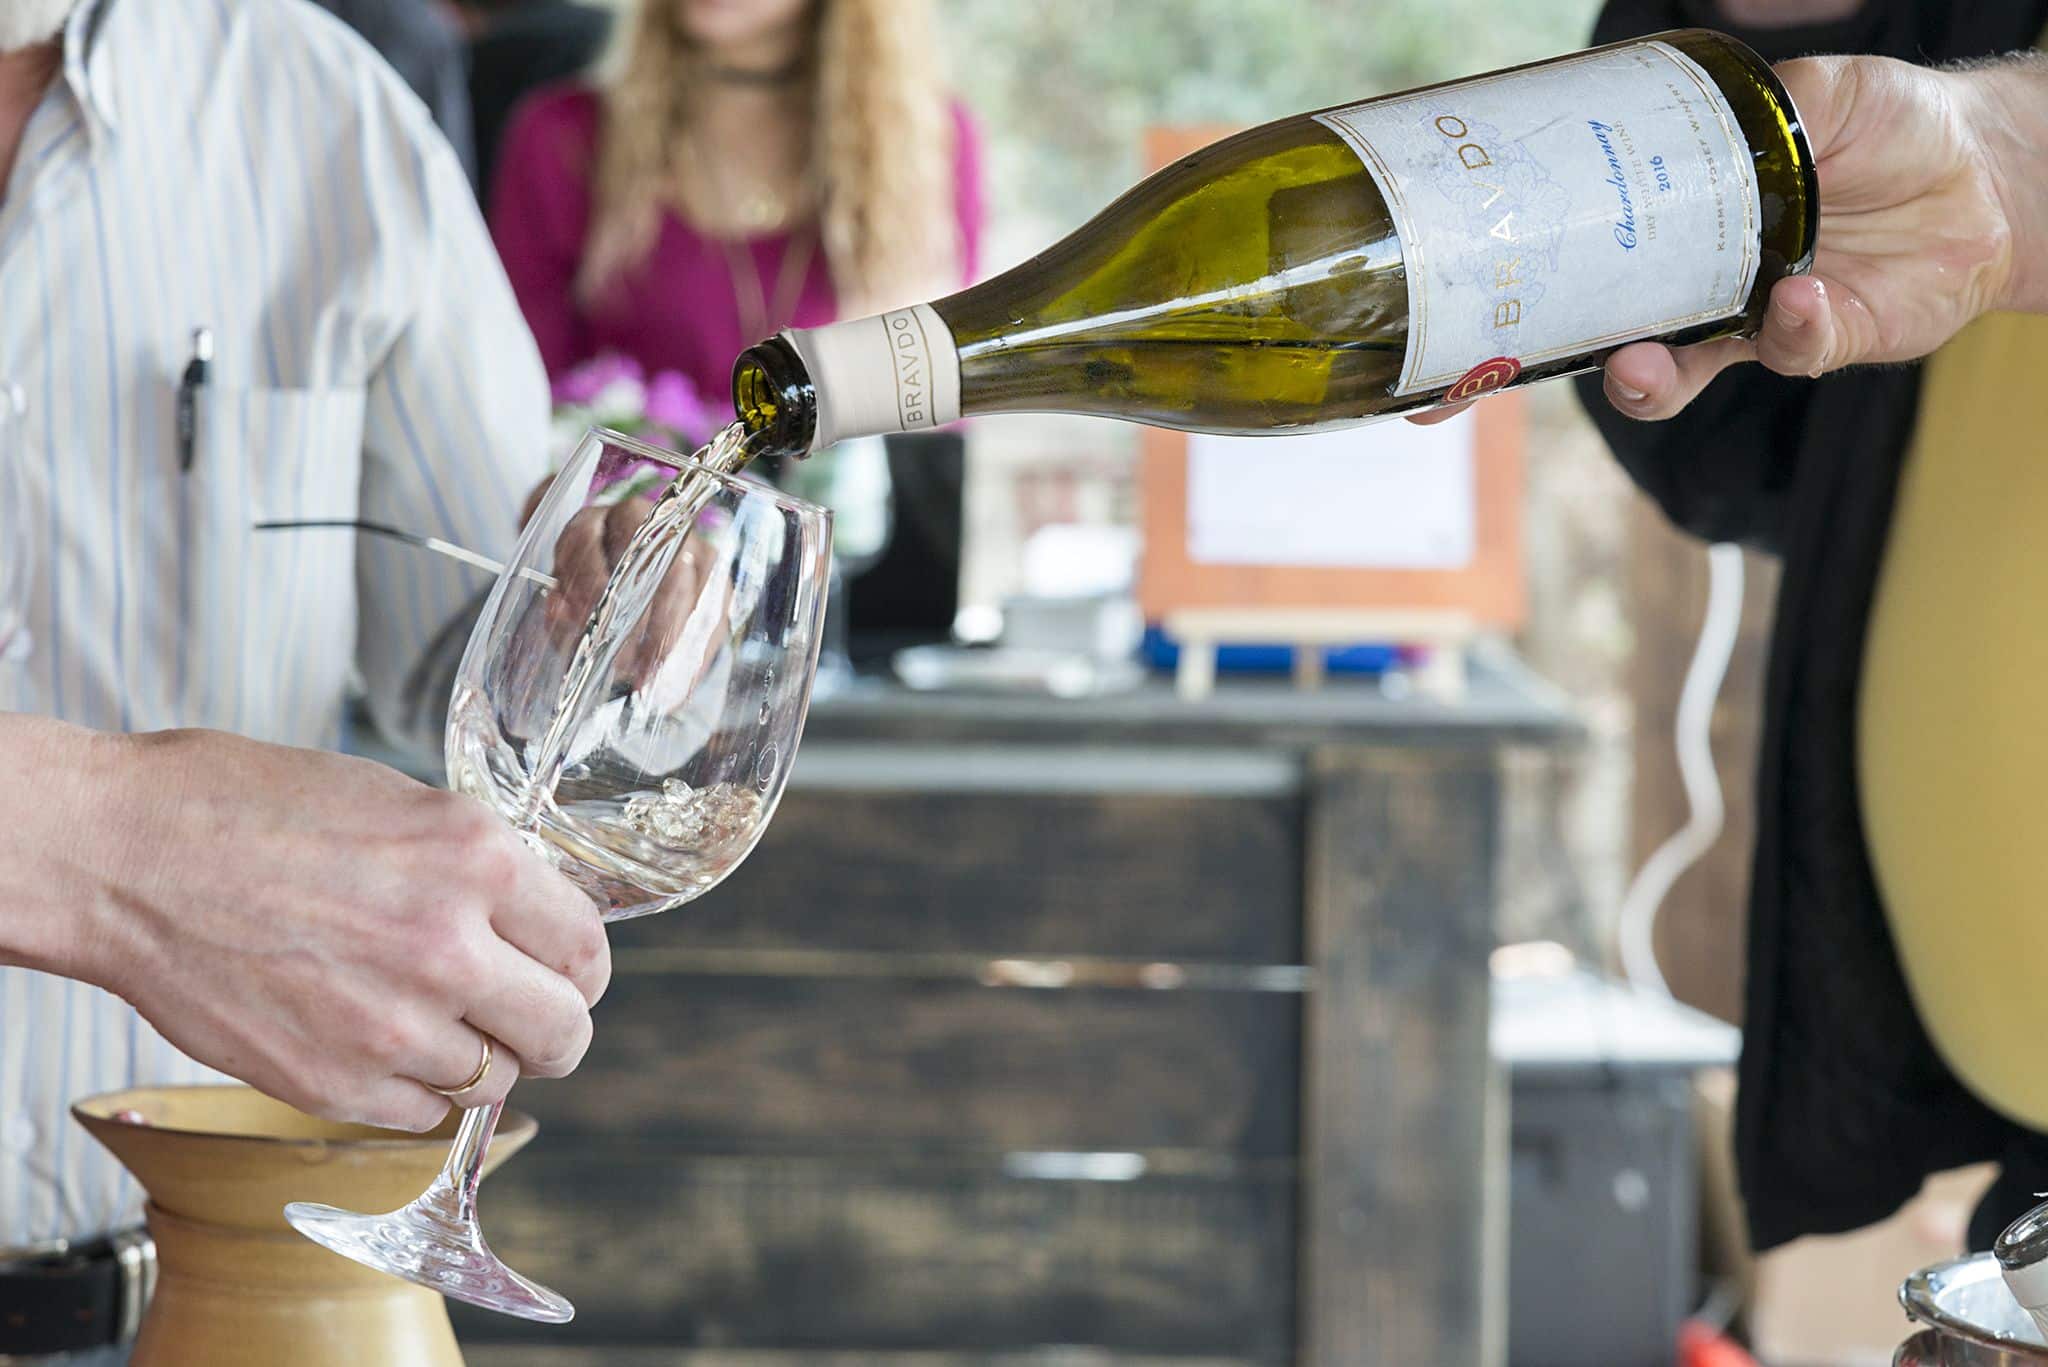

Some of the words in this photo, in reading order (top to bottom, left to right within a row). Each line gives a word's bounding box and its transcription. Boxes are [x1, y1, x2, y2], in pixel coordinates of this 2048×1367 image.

[1666, 83, 1700, 133] WINERY
[1614, 120, 1636, 156] WINE
[1588, 119, 1637, 250] Chardonnay
[1650, 155, 1671, 192] 2016
[1699, 139, 1717, 185] YOSEF
[1435, 115, 1521, 329] BRAVDO
[1646, 214, 1657, 241] DRY
[892, 317, 923, 423] BRAVDO
[1461, 370, 1499, 397] B
